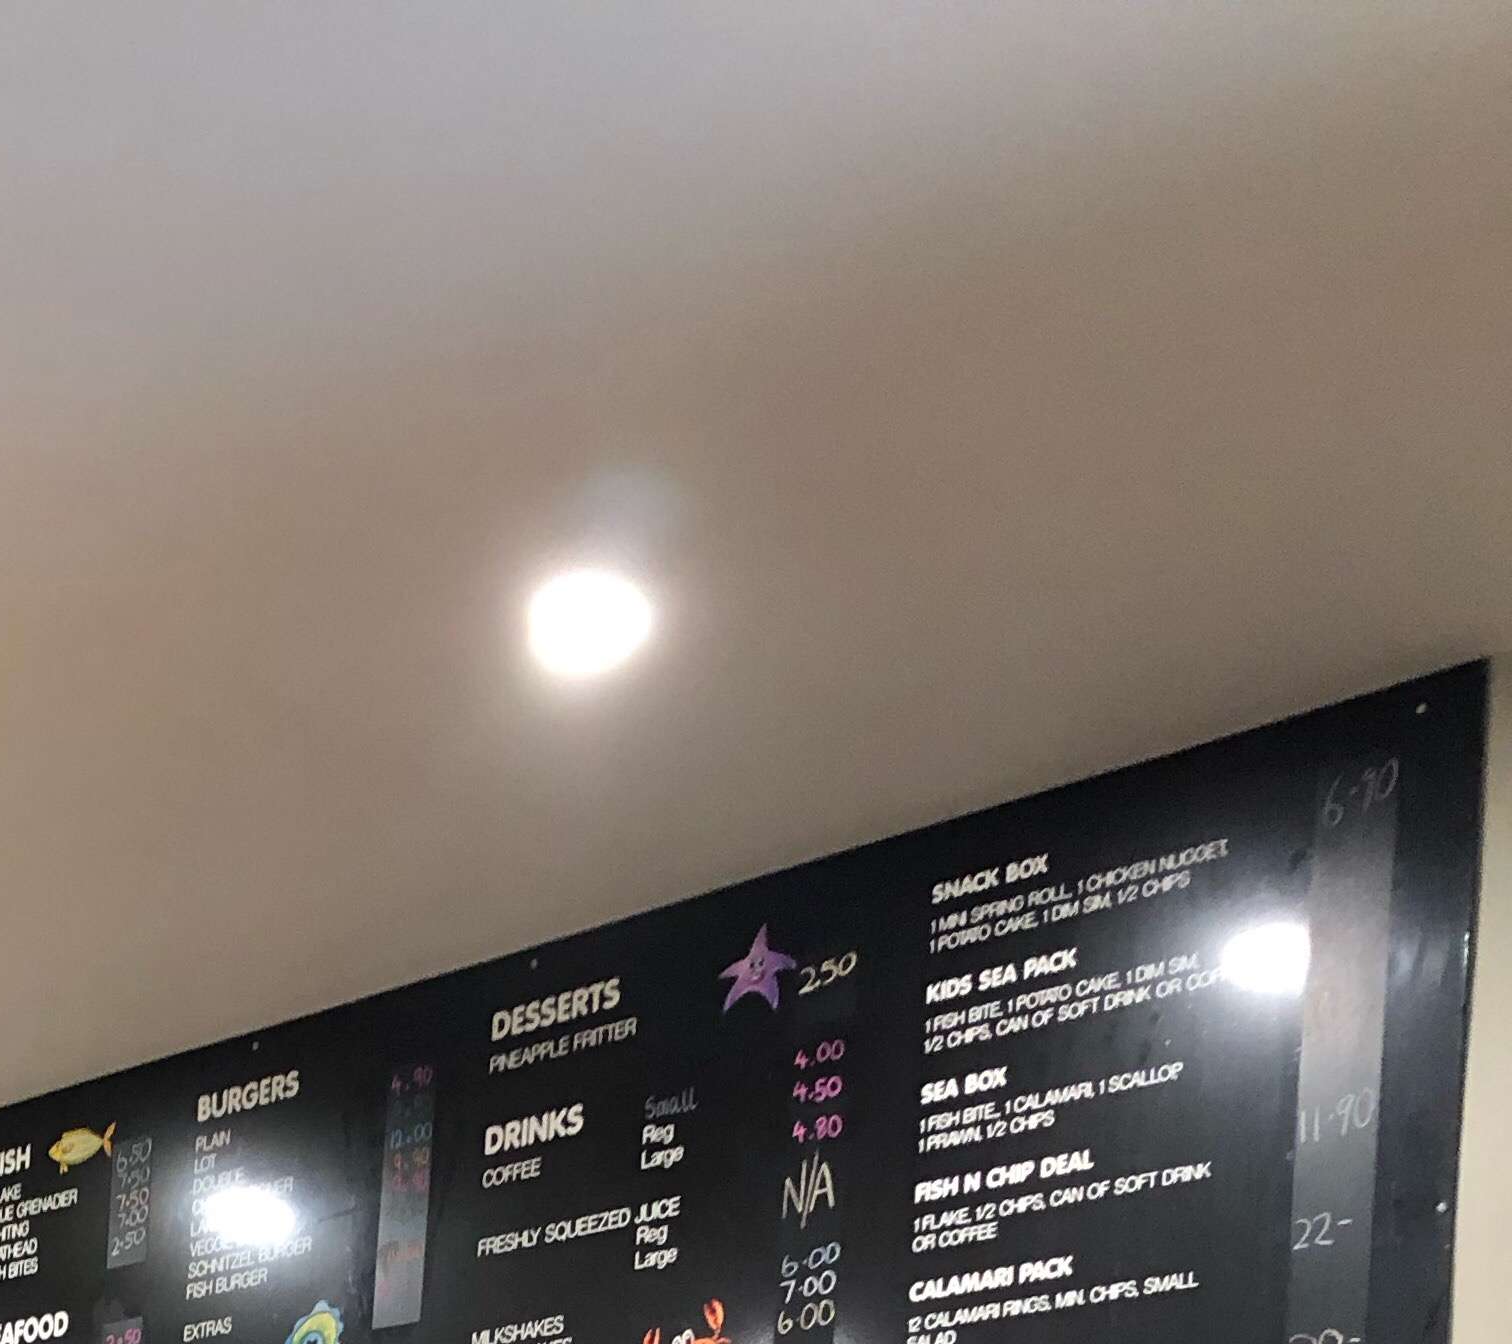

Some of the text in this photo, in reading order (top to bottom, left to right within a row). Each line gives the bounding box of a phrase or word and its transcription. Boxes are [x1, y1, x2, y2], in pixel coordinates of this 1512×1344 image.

[932, 853, 1050, 904] SNACK BOX
[926, 948, 1078, 1004] KIDS SEA PACK
[491, 976, 620, 1041] DESSERTS
[490, 1018, 637, 1074] PINEAPPLE FRITTER
[197, 1070, 299, 1122] BURGERS
[921, 1066, 1008, 1105] SEA BOX
[195, 1129, 230, 1152] PLAIN
[485, 1103, 584, 1156] DRINKS
[642, 1123, 674, 1145] Reg
[194, 1153, 216, 1173] LOT
[482, 1157, 541, 1189] COFFEE
[641, 1146, 684, 1170] Large
[915, 1149, 1094, 1204] FISH N CHIP DEAL
[17, 1188, 78, 1219] GRENADIER
[478, 1196, 682, 1257] FRESHLY SQUEEZED JUICE
[636, 1225, 668, 1246] Reg
[9, 1259, 38, 1280] BITES
[188, 1248, 255, 1279] SCHNITZEL
[634, 1247, 677, 1270] Large
[186, 1279, 212, 1300] FISH
[909, 1255, 1073, 1302] CALAMARI PACK
[183, 1316, 232, 1342] EXTRAS
